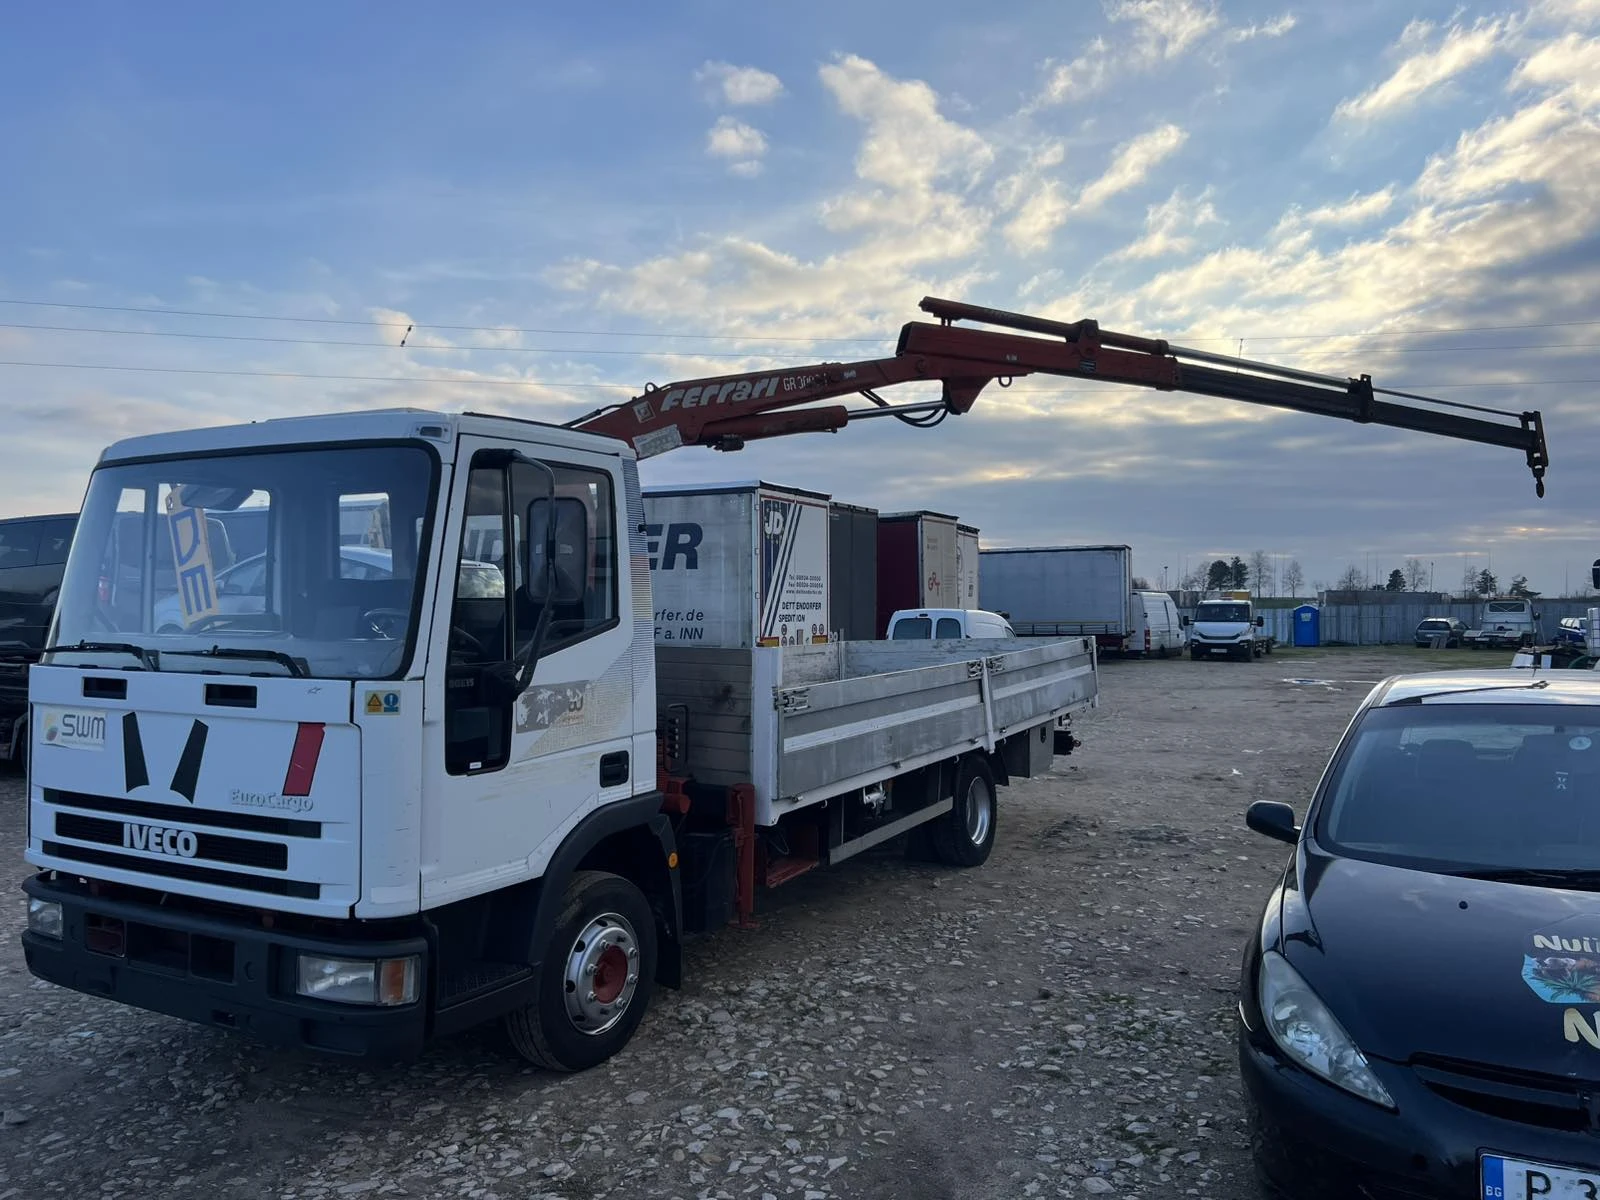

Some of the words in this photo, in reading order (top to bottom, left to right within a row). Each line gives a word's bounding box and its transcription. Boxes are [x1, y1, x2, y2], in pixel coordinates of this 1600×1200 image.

[660, 377, 779, 412] Ferrari
[783, 376, 797, 391] GR
[765, 510, 784, 535] JD
[654, 608, 704, 621] rfer.de
[680, 627, 703, 640] INN
[62, 713, 106, 740] SWM
[231, 788, 314, 813] EuroCargo
[123, 823, 198, 858] IVECO
[1485, 1185, 1503, 1198] BG
[1526, 1169, 1552, 1200] P
